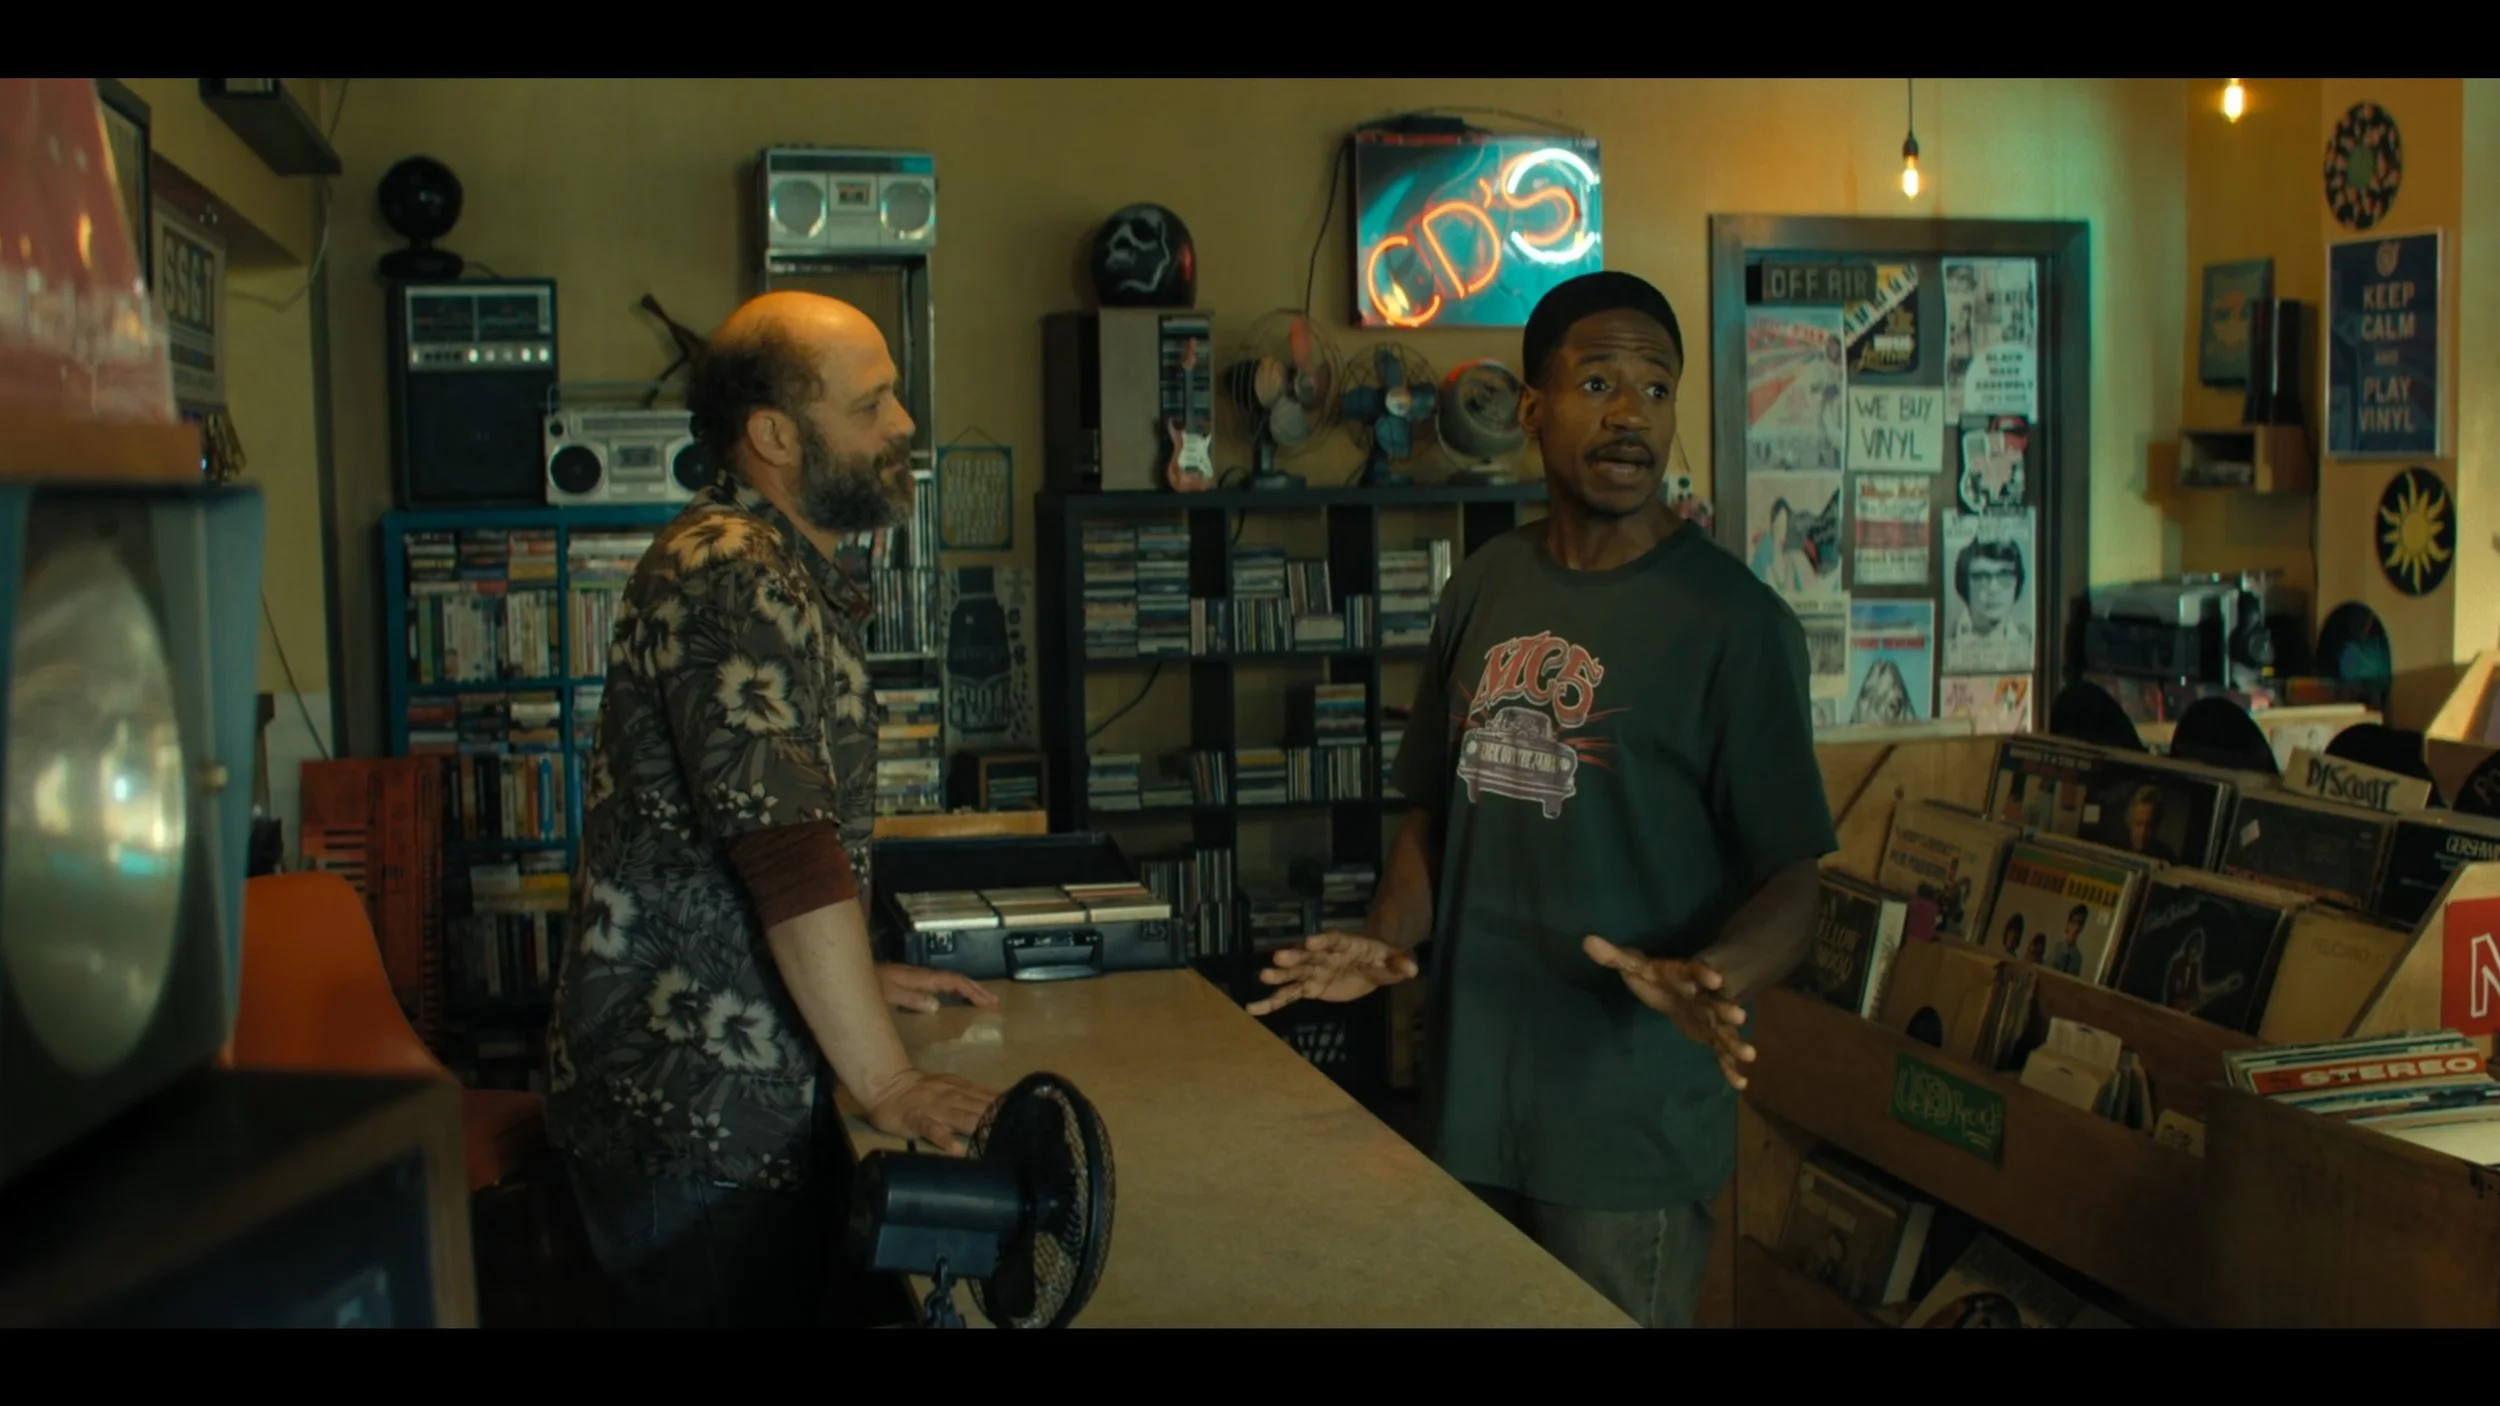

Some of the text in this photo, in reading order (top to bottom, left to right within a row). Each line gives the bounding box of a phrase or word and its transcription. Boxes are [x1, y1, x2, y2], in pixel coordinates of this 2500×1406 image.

[1367, 151, 1582, 328] CD'S
[1771, 267, 1869, 300] OFF AIR
[2364, 280, 2415, 310] KEEP
[2361, 312, 2415, 341] CALM
[2362, 376, 2414, 404] PLAY
[1855, 393, 1933, 423] WE BUY
[2359, 404, 2415, 434] VINYL
[1861, 425, 1923, 461] VINYL
[1467, 630, 1605, 729] MC5
[2299, 1056, 2477, 1087] STEREO
